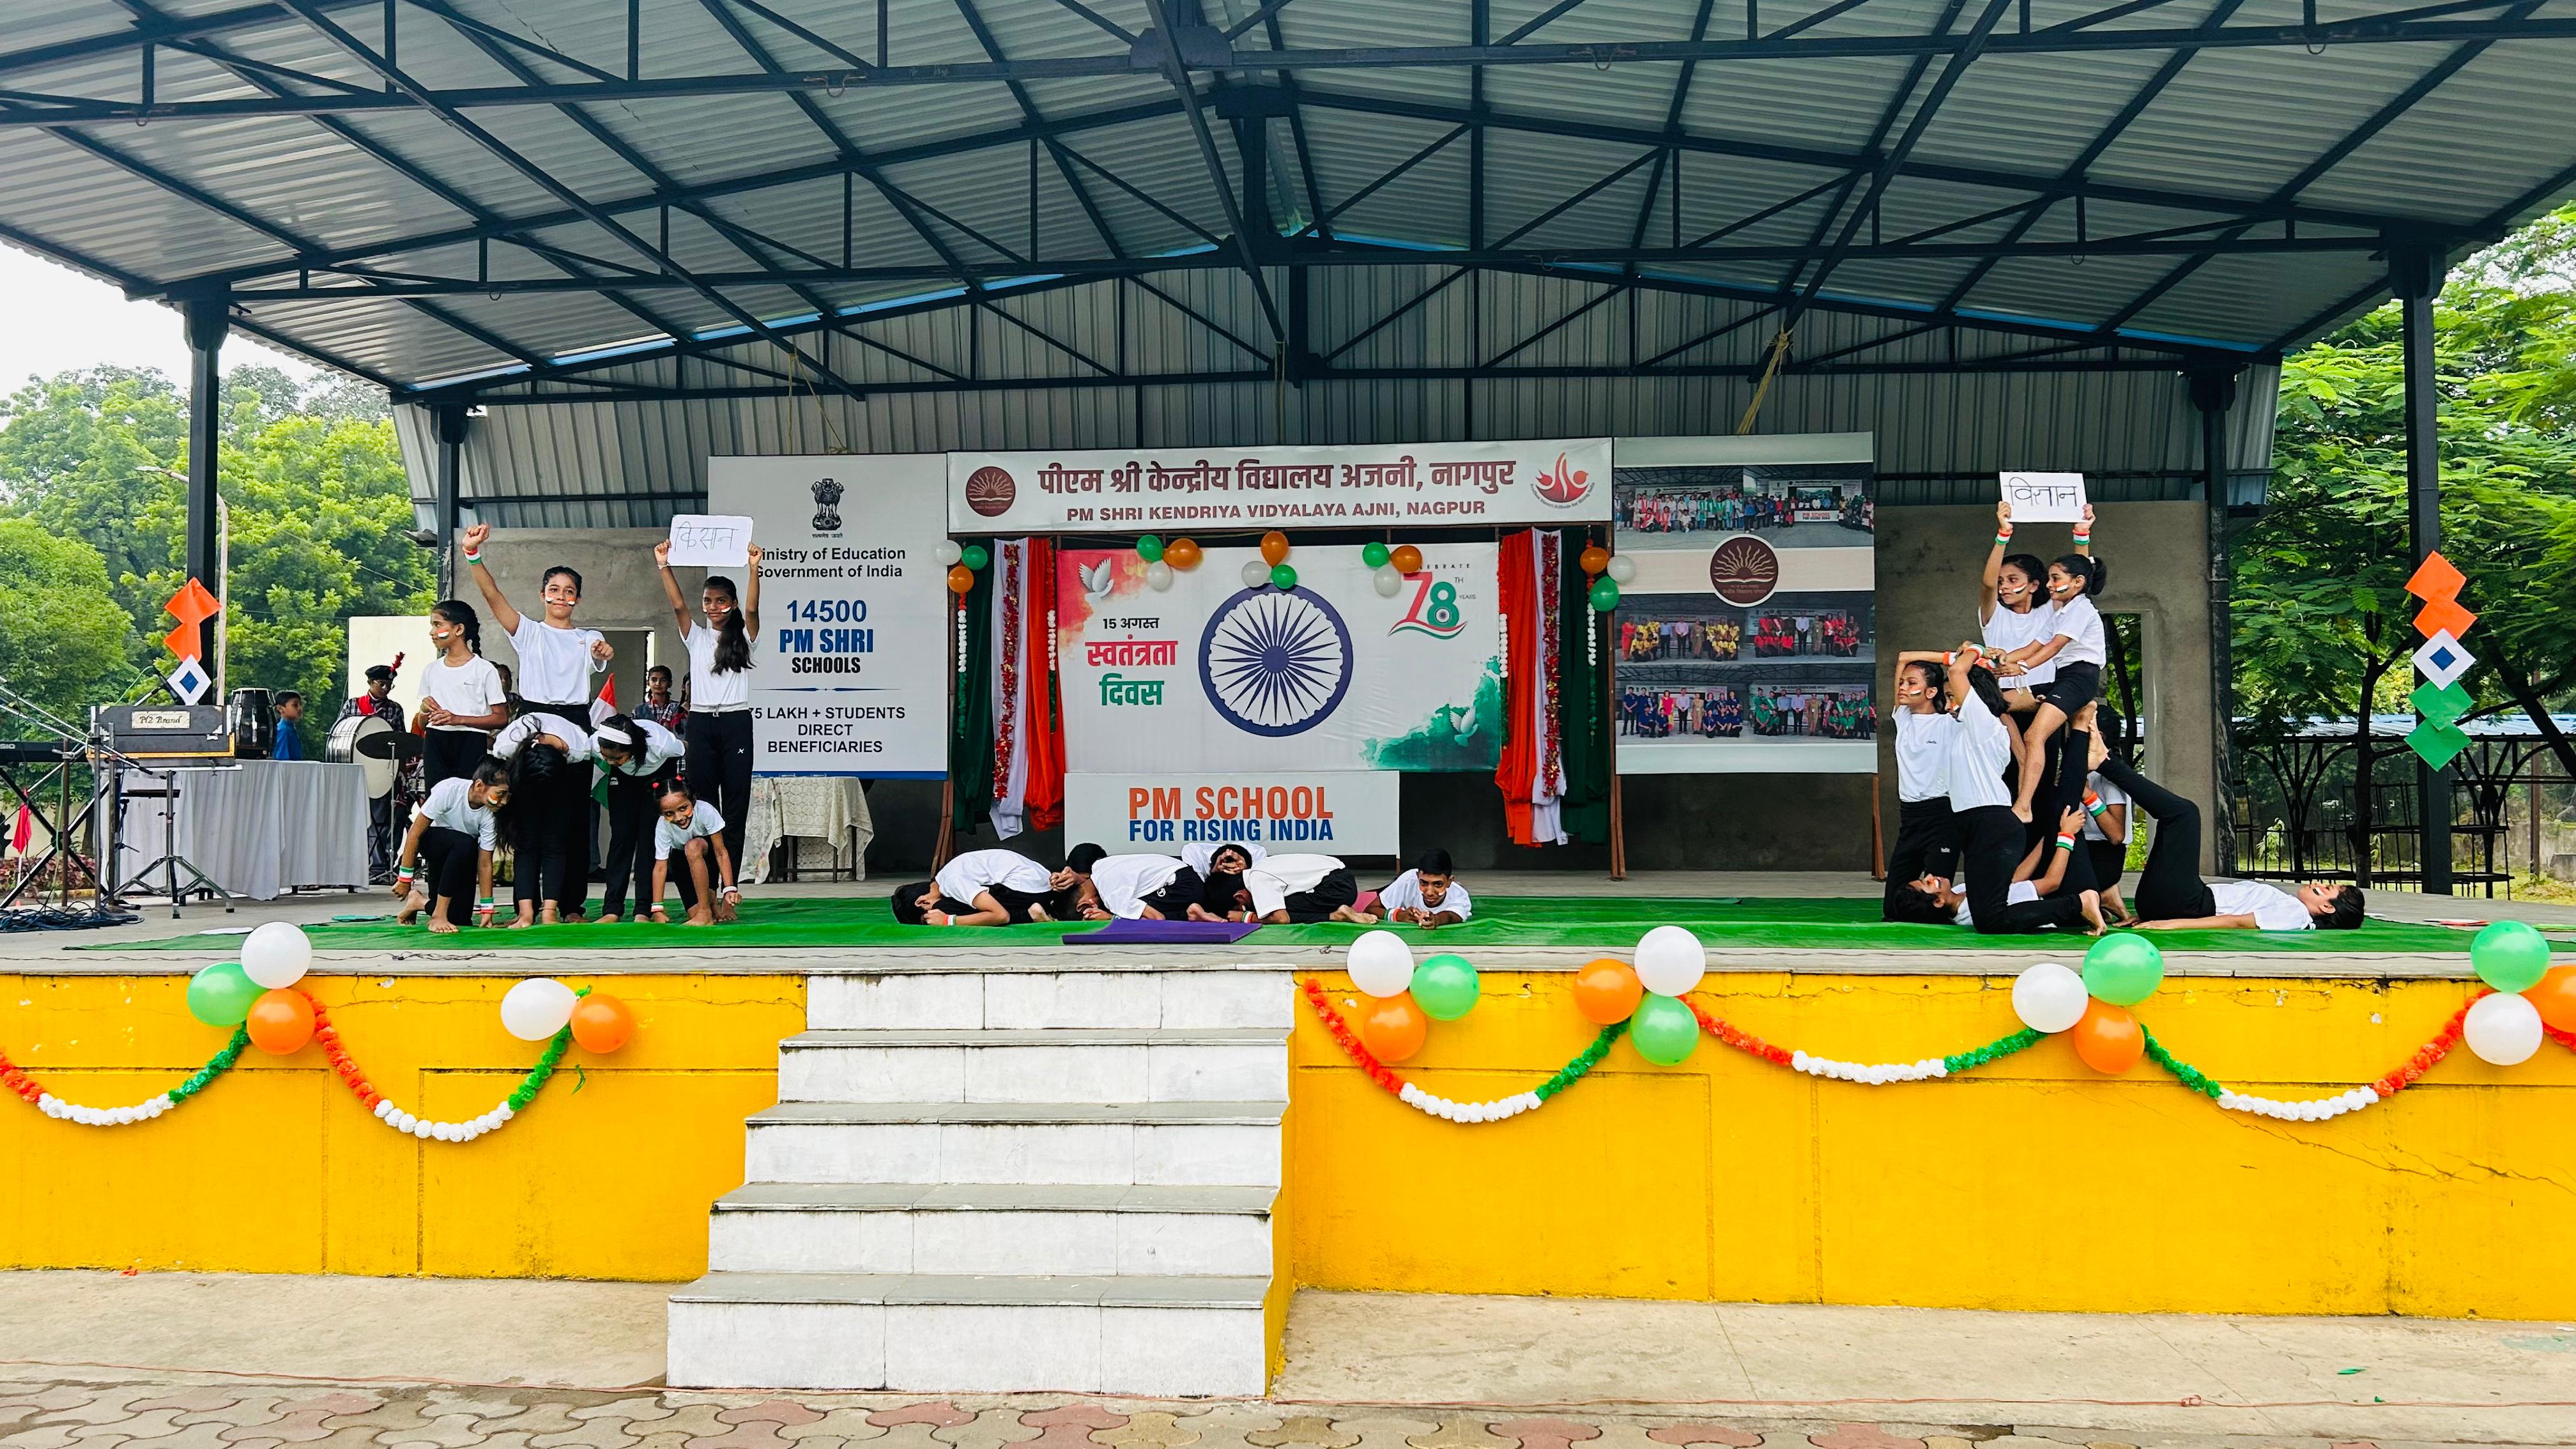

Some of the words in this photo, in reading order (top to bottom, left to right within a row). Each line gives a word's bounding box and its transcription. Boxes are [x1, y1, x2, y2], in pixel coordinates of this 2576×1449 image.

[1038, 462, 1104, 494] पीएम
[1110, 461, 1142, 493] श्री
[1146, 459, 1232, 494] केन्द्रीय
[1236, 459, 1334, 490] विद्यालय
[1340, 455, 1423, 492] अजनी,
[1429, 460, 1516, 494] नागपुर
[1067, 508, 1093, 521] PM
[1100, 507, 1142, 521] SHRI
[1149, 505, 1241, 520] KENDRIYA
[1246, 503, 1347, 518] VIDYALAYA
[1352, 502, 1400, 518] AJNI,
[1406, 501, 1485, 516] NAGPUR
[675, 521, 739, 552] किसान
[762, 548, 808, 563] inistry
[813, 548, 828, 560] of
[832, 547, 906, 560] Education
[848, 565, 863, 578] of
[867, 564, 903, 578] India
[787, 600, 867, 622] 14500
[1103, 618, 1117, 629] 15
[1121, 618, 1160, 629] अगस्त
[779, 629, 813, 653] PM
[820, 629, 873, 653] SHRI
[1085, 634, 1178, 666] स्वतंत्रता
[792, 657, 861, 673] SCHOOLS
[1099, 673, 1165, 706] दिवस
[155, 716, 183, 724] Brand
[767, 707, 808, 719] LAKH
[812, 709, 820, 717] +
[825, 707, 905, 719] STUDENTS
[798, 724, 854, 736] DIRECT
[768, 740, 883, 753] BENEFICIARIES
[1129, 787, 1181, 820] PM
[1195, 786, 1333, 820] SCHOOL
[1129, 820, 1174, 841] FOR
[1184, 820, 1261, 841] RISING
[1270, 819, 1333, 841] INDIA
